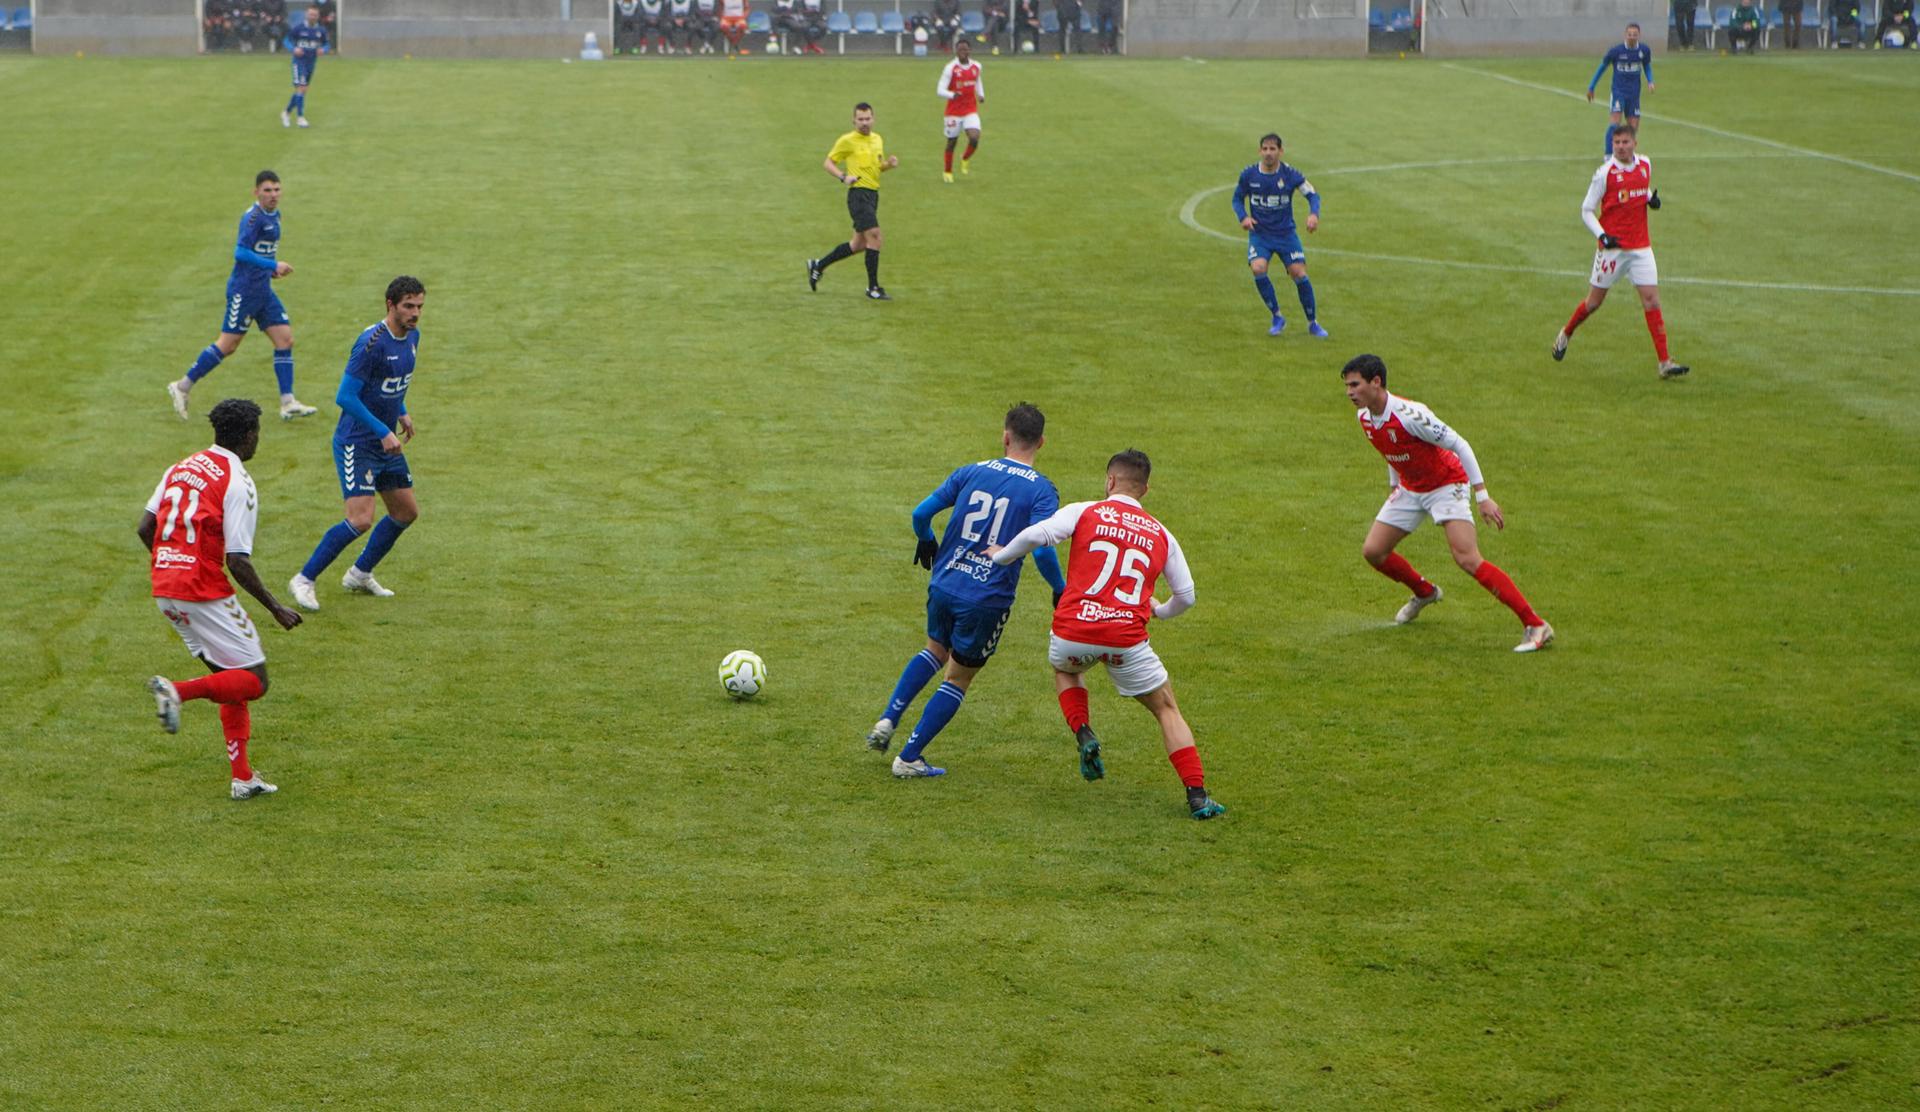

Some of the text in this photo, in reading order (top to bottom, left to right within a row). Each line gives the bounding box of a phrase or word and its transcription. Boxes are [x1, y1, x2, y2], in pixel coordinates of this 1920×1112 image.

[987, 459, 1039, 482] for walk
[961, 490, 1010, 545] 21
[1122, 512, 1160, 531] amco
[1096, 524, 1154, 551] MARTINS
[1084, 540, 1151, 605] 75
